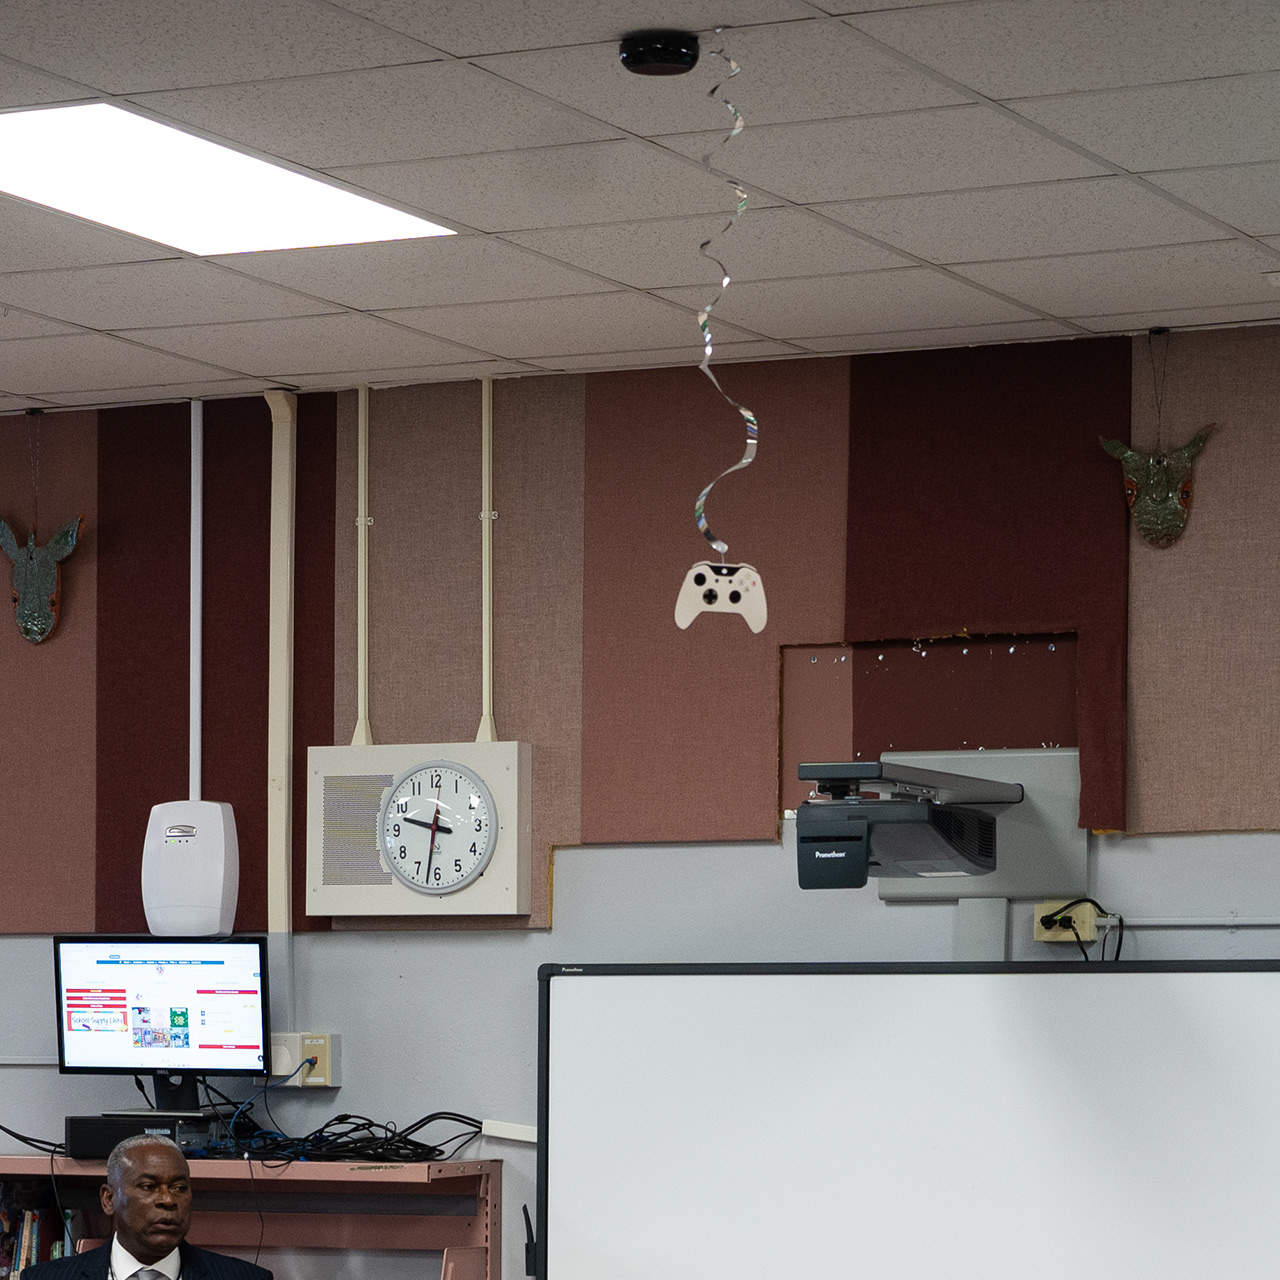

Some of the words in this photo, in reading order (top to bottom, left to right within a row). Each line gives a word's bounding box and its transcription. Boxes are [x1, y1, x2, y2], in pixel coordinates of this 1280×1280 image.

[431, 774, 442, 788] 12
[393, 824, 400, 837] 9
[475, 818, 482, 832] 3
[399, 845, 407, 859] 8
[470, 842, 477, 856] 4
[415, 861, 421, 875] 7
[454, 859, 462, 872] 5
[434, 867, 441, 881] 6
